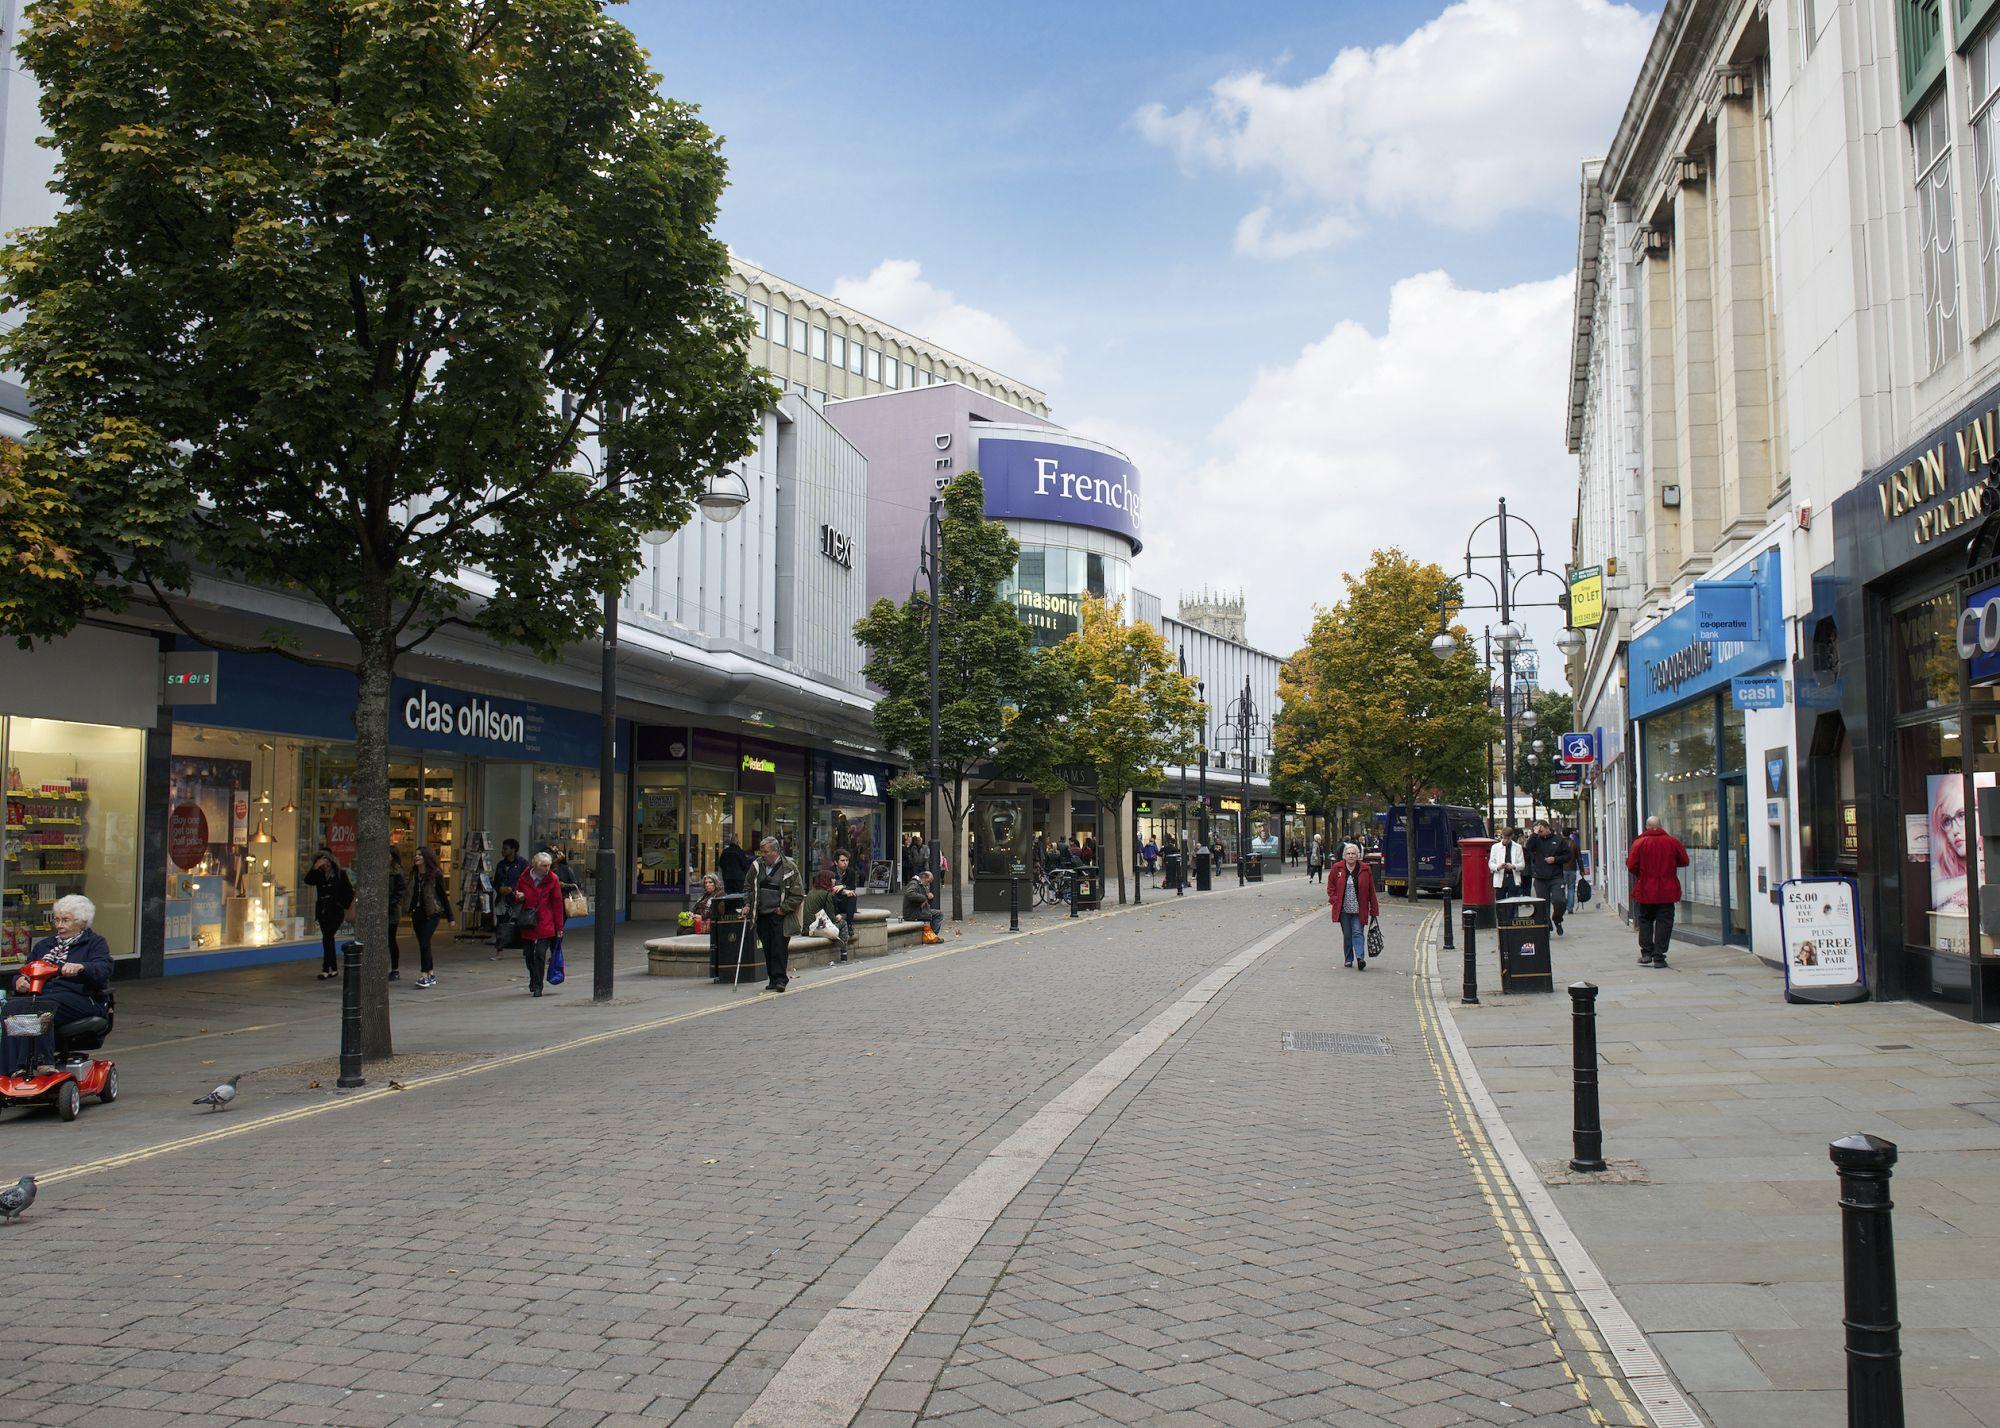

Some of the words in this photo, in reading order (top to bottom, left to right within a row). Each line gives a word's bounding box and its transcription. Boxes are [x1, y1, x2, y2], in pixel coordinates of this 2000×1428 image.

[1878, 440, 1945, 521] VISION
[1034, 458, 1143, 529] Frenchg
[822, 524, 856, 570] next
[1573, 594, 1584, 604] TO
[1586, 590, 1600, 602] LET
[1028, 613, 1057, 630] STORE
[1700, 611, 1713, 619] The
[1700, 620, 1747, 629] co-operative
[1700, 631, 1719, 639] bank
[167, 671, 210, 685] savers
[1738, 685, 1776, 701] cash
[405, 689, 454, 734] clas
[458, 698, 524, 743] ohlson
[833, 770, 863, 791] TRESPASS
[174, 816, 186, 825] Buy
[331, 826, 355, 842] 20%
[1788, 893, 1818, 903] £5.00
[1818, 938, 1852, 949] FREE
